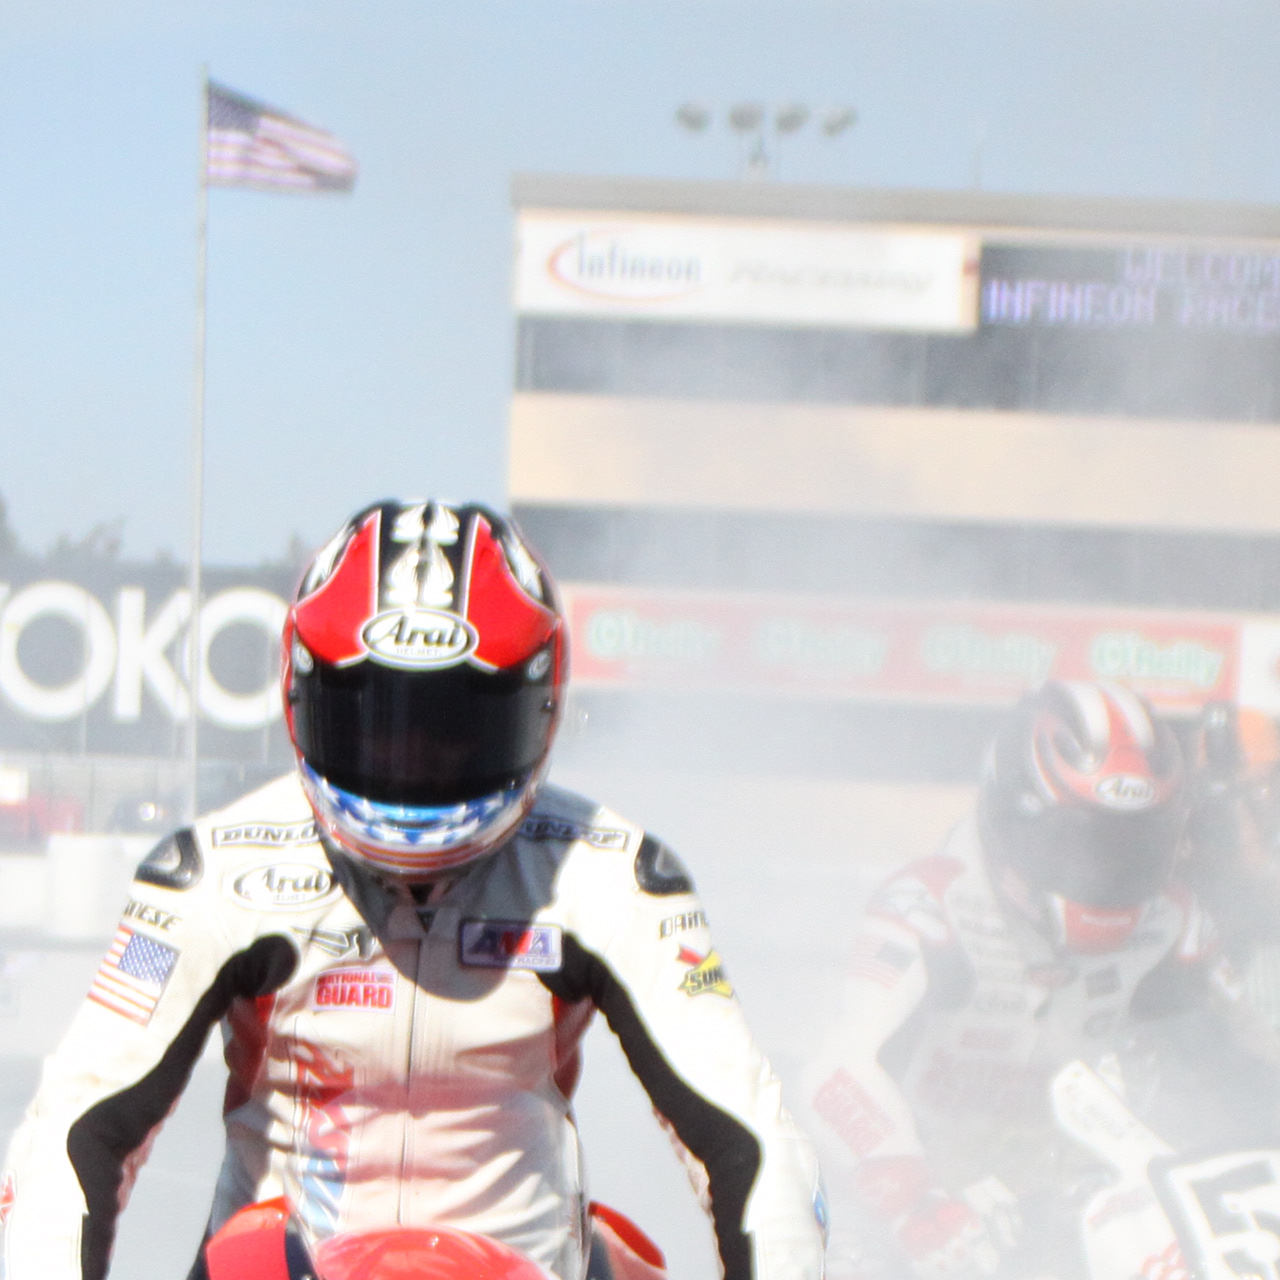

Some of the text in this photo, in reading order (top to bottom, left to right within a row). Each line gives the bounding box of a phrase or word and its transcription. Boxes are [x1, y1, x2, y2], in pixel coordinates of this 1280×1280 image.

[575, 231, 702, 283] Infineon
[986, 281, 1158, 325] INFINEON
[372, 614, 460, 648] Arai
[316, 984, 393, 1009] GUARD
